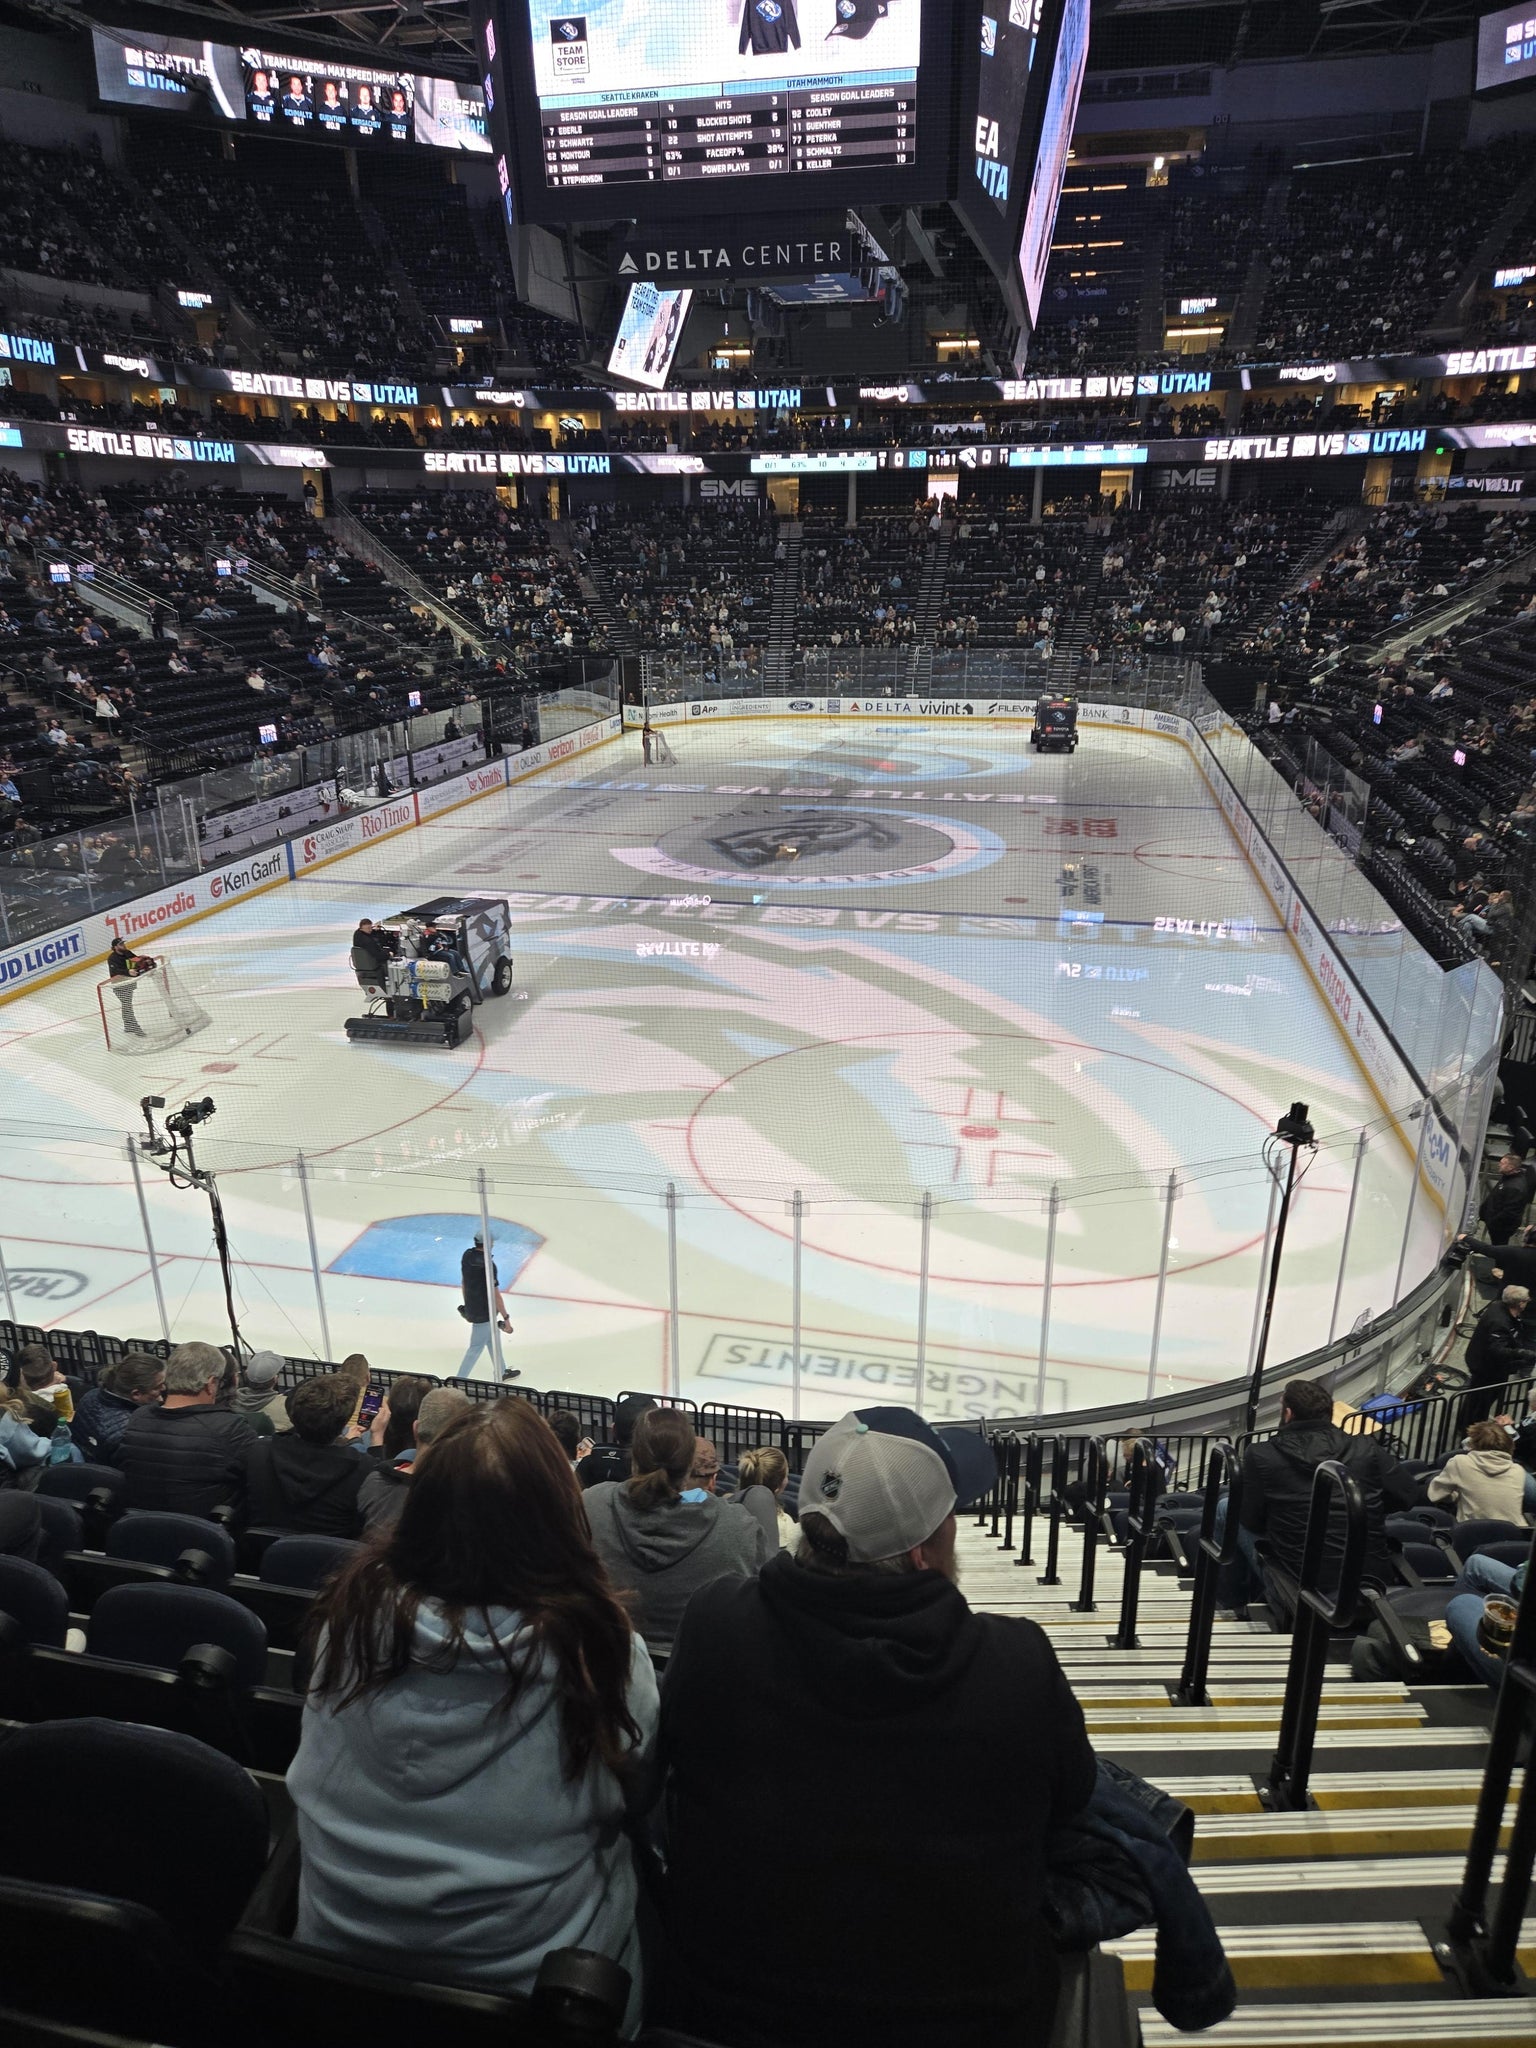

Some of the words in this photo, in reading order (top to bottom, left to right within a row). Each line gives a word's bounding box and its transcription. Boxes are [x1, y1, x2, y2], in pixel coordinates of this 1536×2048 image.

[558, 46, 582, 55] TEAM
[263, 55, 288, 70] TEAM
[328, 64, 346, 78] MAX
[346, 67, 372, 82] SPEED
[556, 56, 586, 66] STORE
[787, 78, 806, 88] UTAH
[807, 76, 842, 86] MAMMOTH
[602, 94, 630, 102] SEATTLE
[632, 91, 658, 100] KRAKEN
[810, 92, 840, 103] SEASON
[840, 91, 860, 100] GOAL
[860, 88, 894, 100] LEADERS
[453, 98, 486, 117] SEAT
[668, 104, 674, 112] 4
[716, 100, 732, 110] HITS
[772, 96, 778, 105] 3
[792, 109, 801, 118] 92
[806, 108, 832, 118] COOLEY
[897, 102, 907, 111] 14
[560, 110, 588, 122] SEASON
[589, 109, 606, 120] GOAL
[607, 108, 638, 118] LEADERS
[668, 120, 678, 129] 10
[697, 116, 728, 128] BLOCKED
[729, 114, 752, 125] SHOTS
[454, 118, 485, 134] UTAH
[549, 128, 554, 136] 7
[558, 126, 582, 136] EBERLE
[793, 123, 801, 132] 11
[806, 120, 841, 130] GUENTHER
[898, 115, 906, 124] 13
[548, 140, 556, 148] 17
[560, 138, 594, 148] SCHWARTZ
[668, 136, 678, 145] 22
[697, 134, 716, 143] SHOT
[716, 131, 752, 142] ATTEMPTS
[771, 128, 780, 138] 19
[792, 136, 802, 145] 77
[806, 133, 838, 144] PETERKA
[897, 128, 906, 138] 12
[976, 115, 999, 158] EA
[547, 152, 557, 161] 62
[560, 150, 590, 160] MONTOUR
[666, 151, 682, 160] 63%
[706, 148, 736, 158] FACEOFF
[737, 146, 744, 156] %
[806, 146, 842, 157] SCHMALTZ
[897, 142, 906, 150] 11
[562, 164, 578, 172] DUNN
[668, 167, 680, 176] 0/1
[702, 164, 726, 174] POWER
[728, 162, 750, 172] PLAYS
[769, 160, 782, 170] 0/1
[806, 160, 832, 170] KELLER
[896, 154, 906, 164] 10
[562, 174, 603, 185] STEPHENSON
[646, 248, 732, 271] DELTA
[742, 242, 841, 266] CENTER
[11, 336, 56, 366] UTAH
[1445, 346, 1536, 375] SEATTLE
[231, 371, 304, 398] SEATTLE
[326, 380, 350, 401] VS
[372, 384, 418, 404] UTAH
[1004, 378, 1082, 400] SEATTLE
[1110, 376, 1134, 396] VS
[1161, 372, 1212, 393] UTAH
[615, 392, 688, 411] SEATTLE
[712, 391, 734, 410] VS
[758, 389, 800, 408] UTAH
[67, 428, 133, 456] SEATTLE
[152, 436, 174, 459] VS
[193, 440, 236, 463] UTAH
[1204, 436, 1290, 461] SEATTLE
[1319, 434, 1344, 456] VS
[1374, 429, 1426, 452] UTAH
[424, 452, 498, 472] SEATTLE
[520, 454, 544, 473] VS
[568, 456, 610, 473] UTAH
[894, 452, 904, 467] 0
[982, 450, 992, 465] 0
[1152, 468, 1218, 488] SME
[700, 480, 758, 497] SME
[660, 710, 678, 718] Health
[793, 702, 810, 710] Ford
[865, 702, 912, 712] DELTA
[919, 701, 960, 714] vivint
[998, 704, 1036, 712] FILEVIN
[1082, 708, 1109, 719] BANK
[1154, 714, 1180, 725] AMERICAN
[1156, 723, 1179, 734] EXPRESS
[548, 740, 575, 760] verizon
[478, 768, 502, 790] Smith's
[714, 785, 770, 795] VS
[846, 789, 1059, 804] SEATTLE
[361, 815, 382, 838] Rio
[380, 806, 410, 829] Tinto
[316, 828, 335, 844] CRAIG
[335, 822, 354, 835] SWAPP
[222, 870, 251, 894] Ken
[251, 853, 281, 882] Garff
[120, 892, 196, 934] Trucordia
[25, 933, 81, 973] LIGHT
[1320, 952, 1352, 1022] entrata
[726, 1343, 1041, 1404] INGREDIENTS
